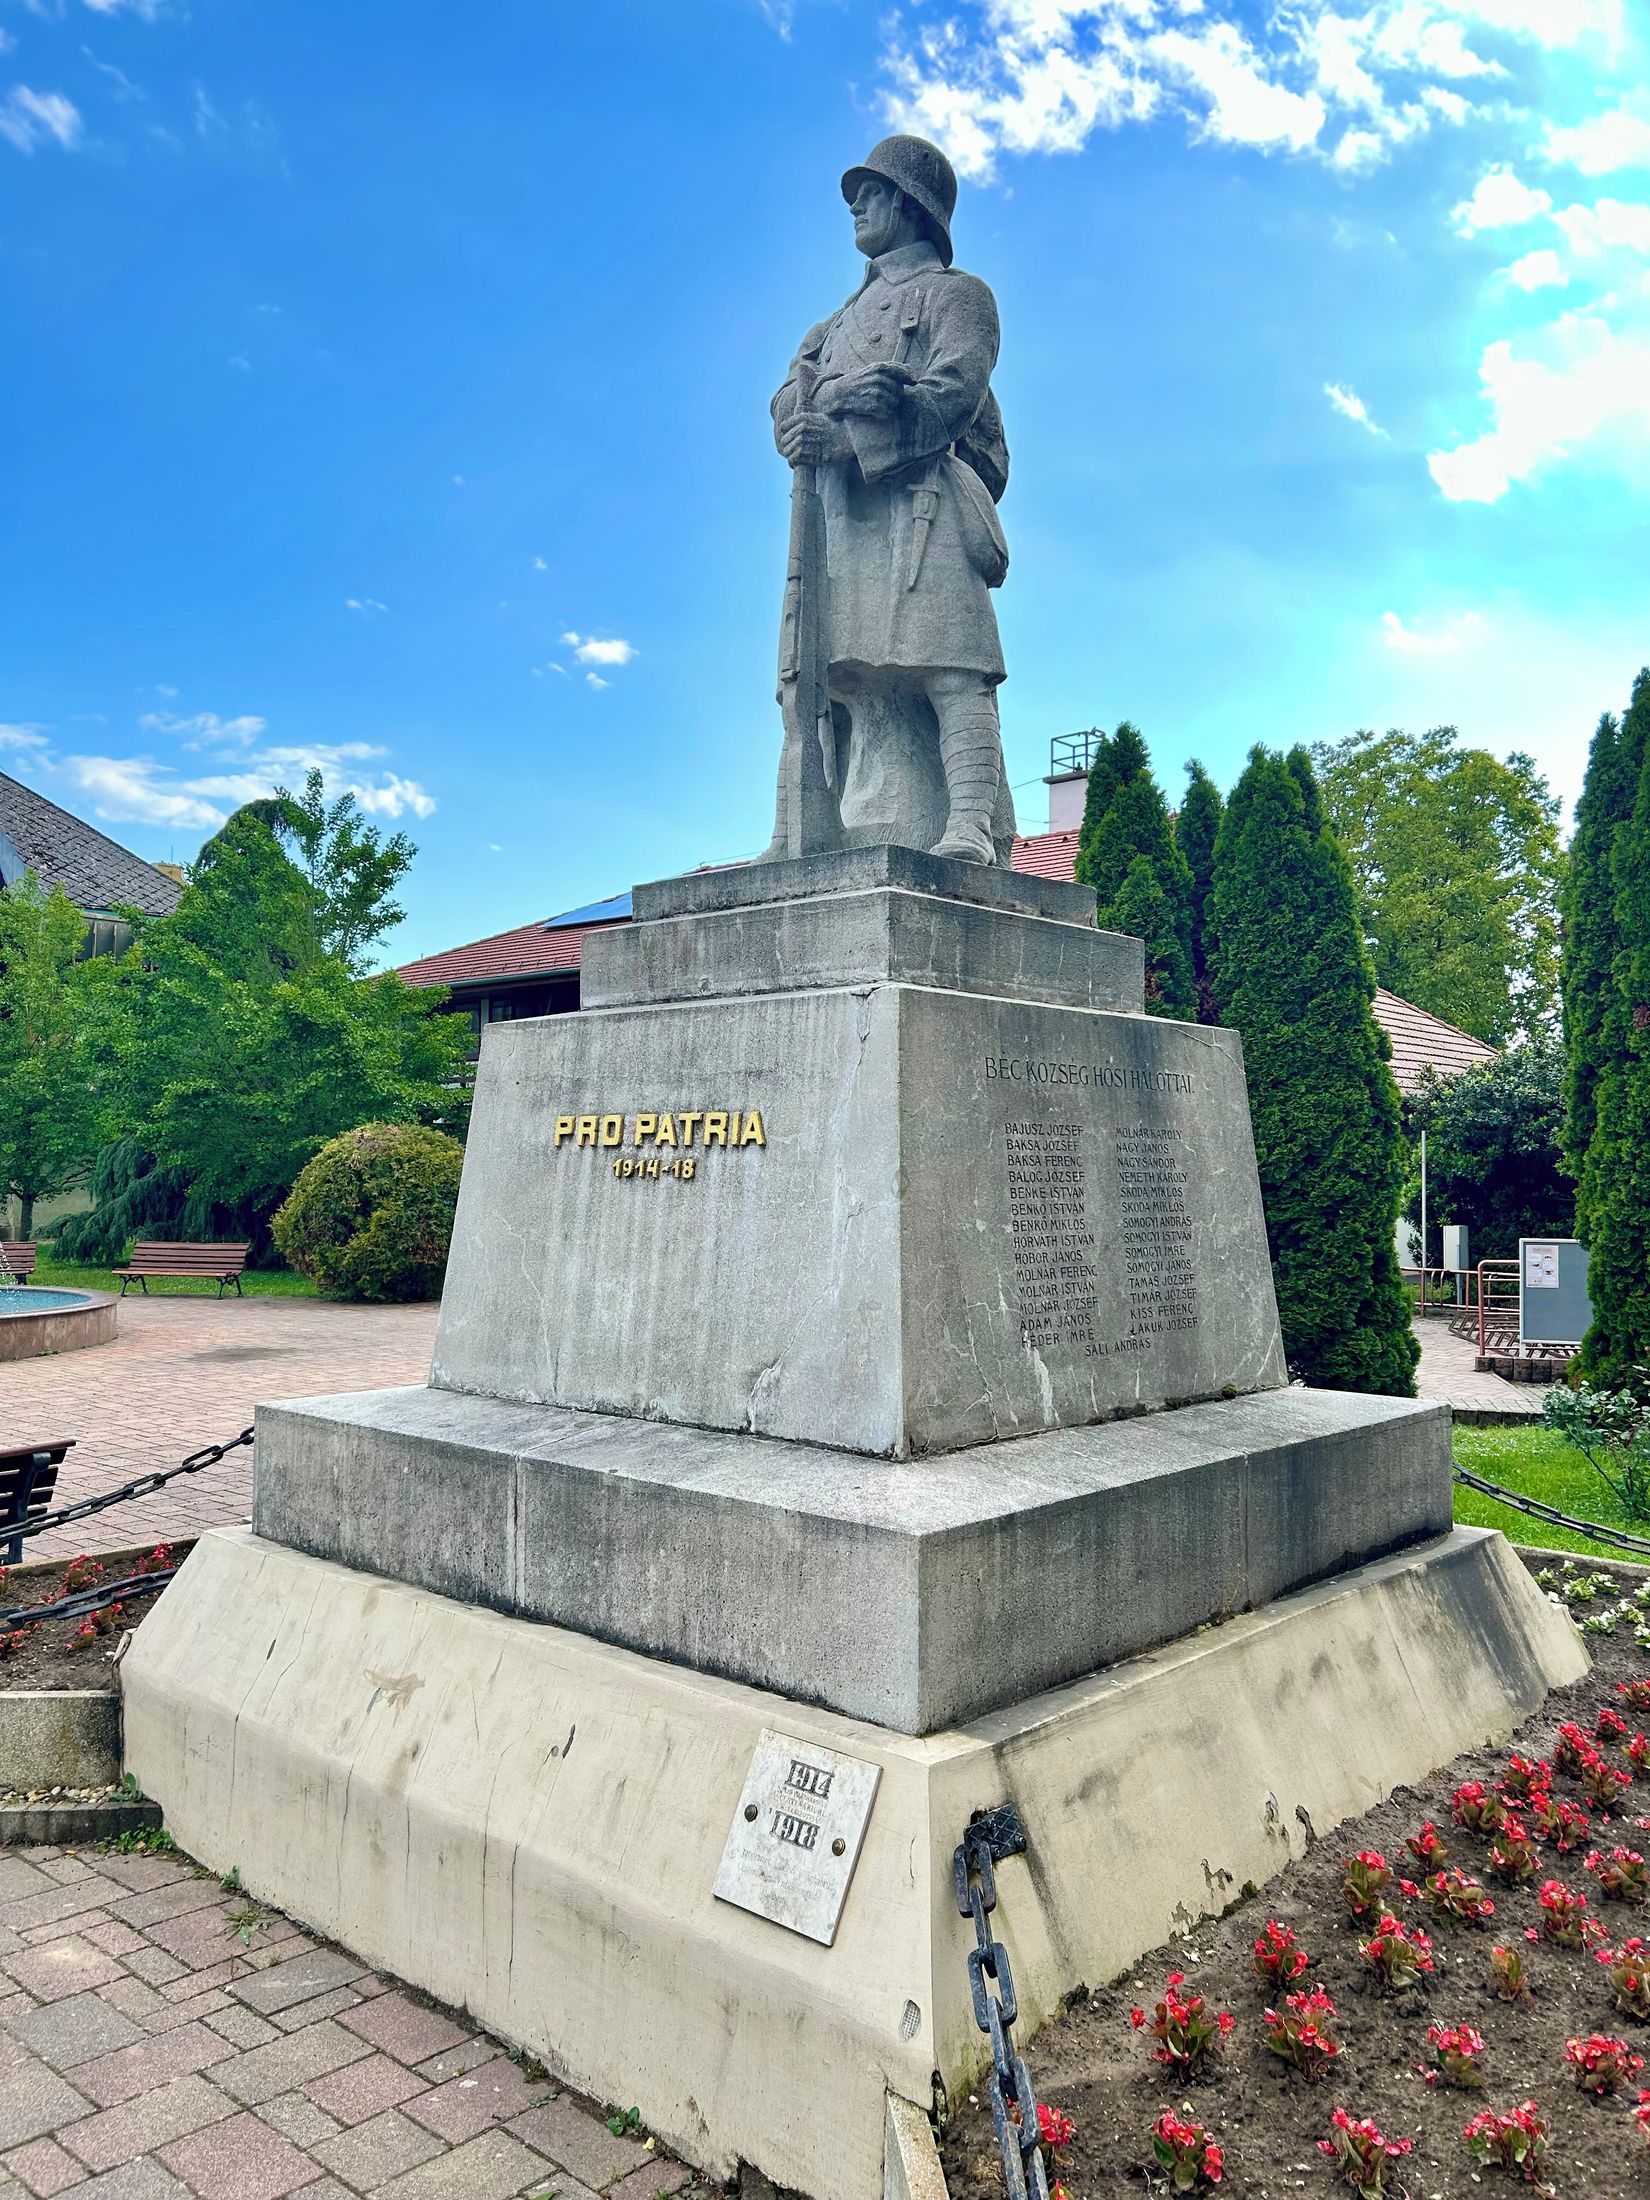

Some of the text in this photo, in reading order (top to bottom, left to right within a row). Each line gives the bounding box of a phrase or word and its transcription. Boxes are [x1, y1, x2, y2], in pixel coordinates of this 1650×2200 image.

[553, 1110, 767, 1148] PRO PATRIA
[1005, 1122, 1044, 1136] BAJUSZ
[1006, 1139, 1041, 1151] BAKSA
[1115, 1142, 1140, 1153] NAGY
[1007, 1154, 1083, 1168] BAKSA FERENC
[1117, 1157, 1141, 1169] NAGY
[613, 1157, 697, 1180] 1914-18
[1010, 1186, 1046, 1199] BENKE
[1163, 1245, 1186, 1257] IMRE
[1060, 1264, 1098, 1279] FERENC
[1130, 1303, 1194, 1320] KISS FERENC
[1066, 1328, 1095, 1343] IMRE
[1084, 1343, 1109, 1357] SALI
[784, 1758, 836, 1801] 1914
[769, 1809, 821, 1852] 1918
